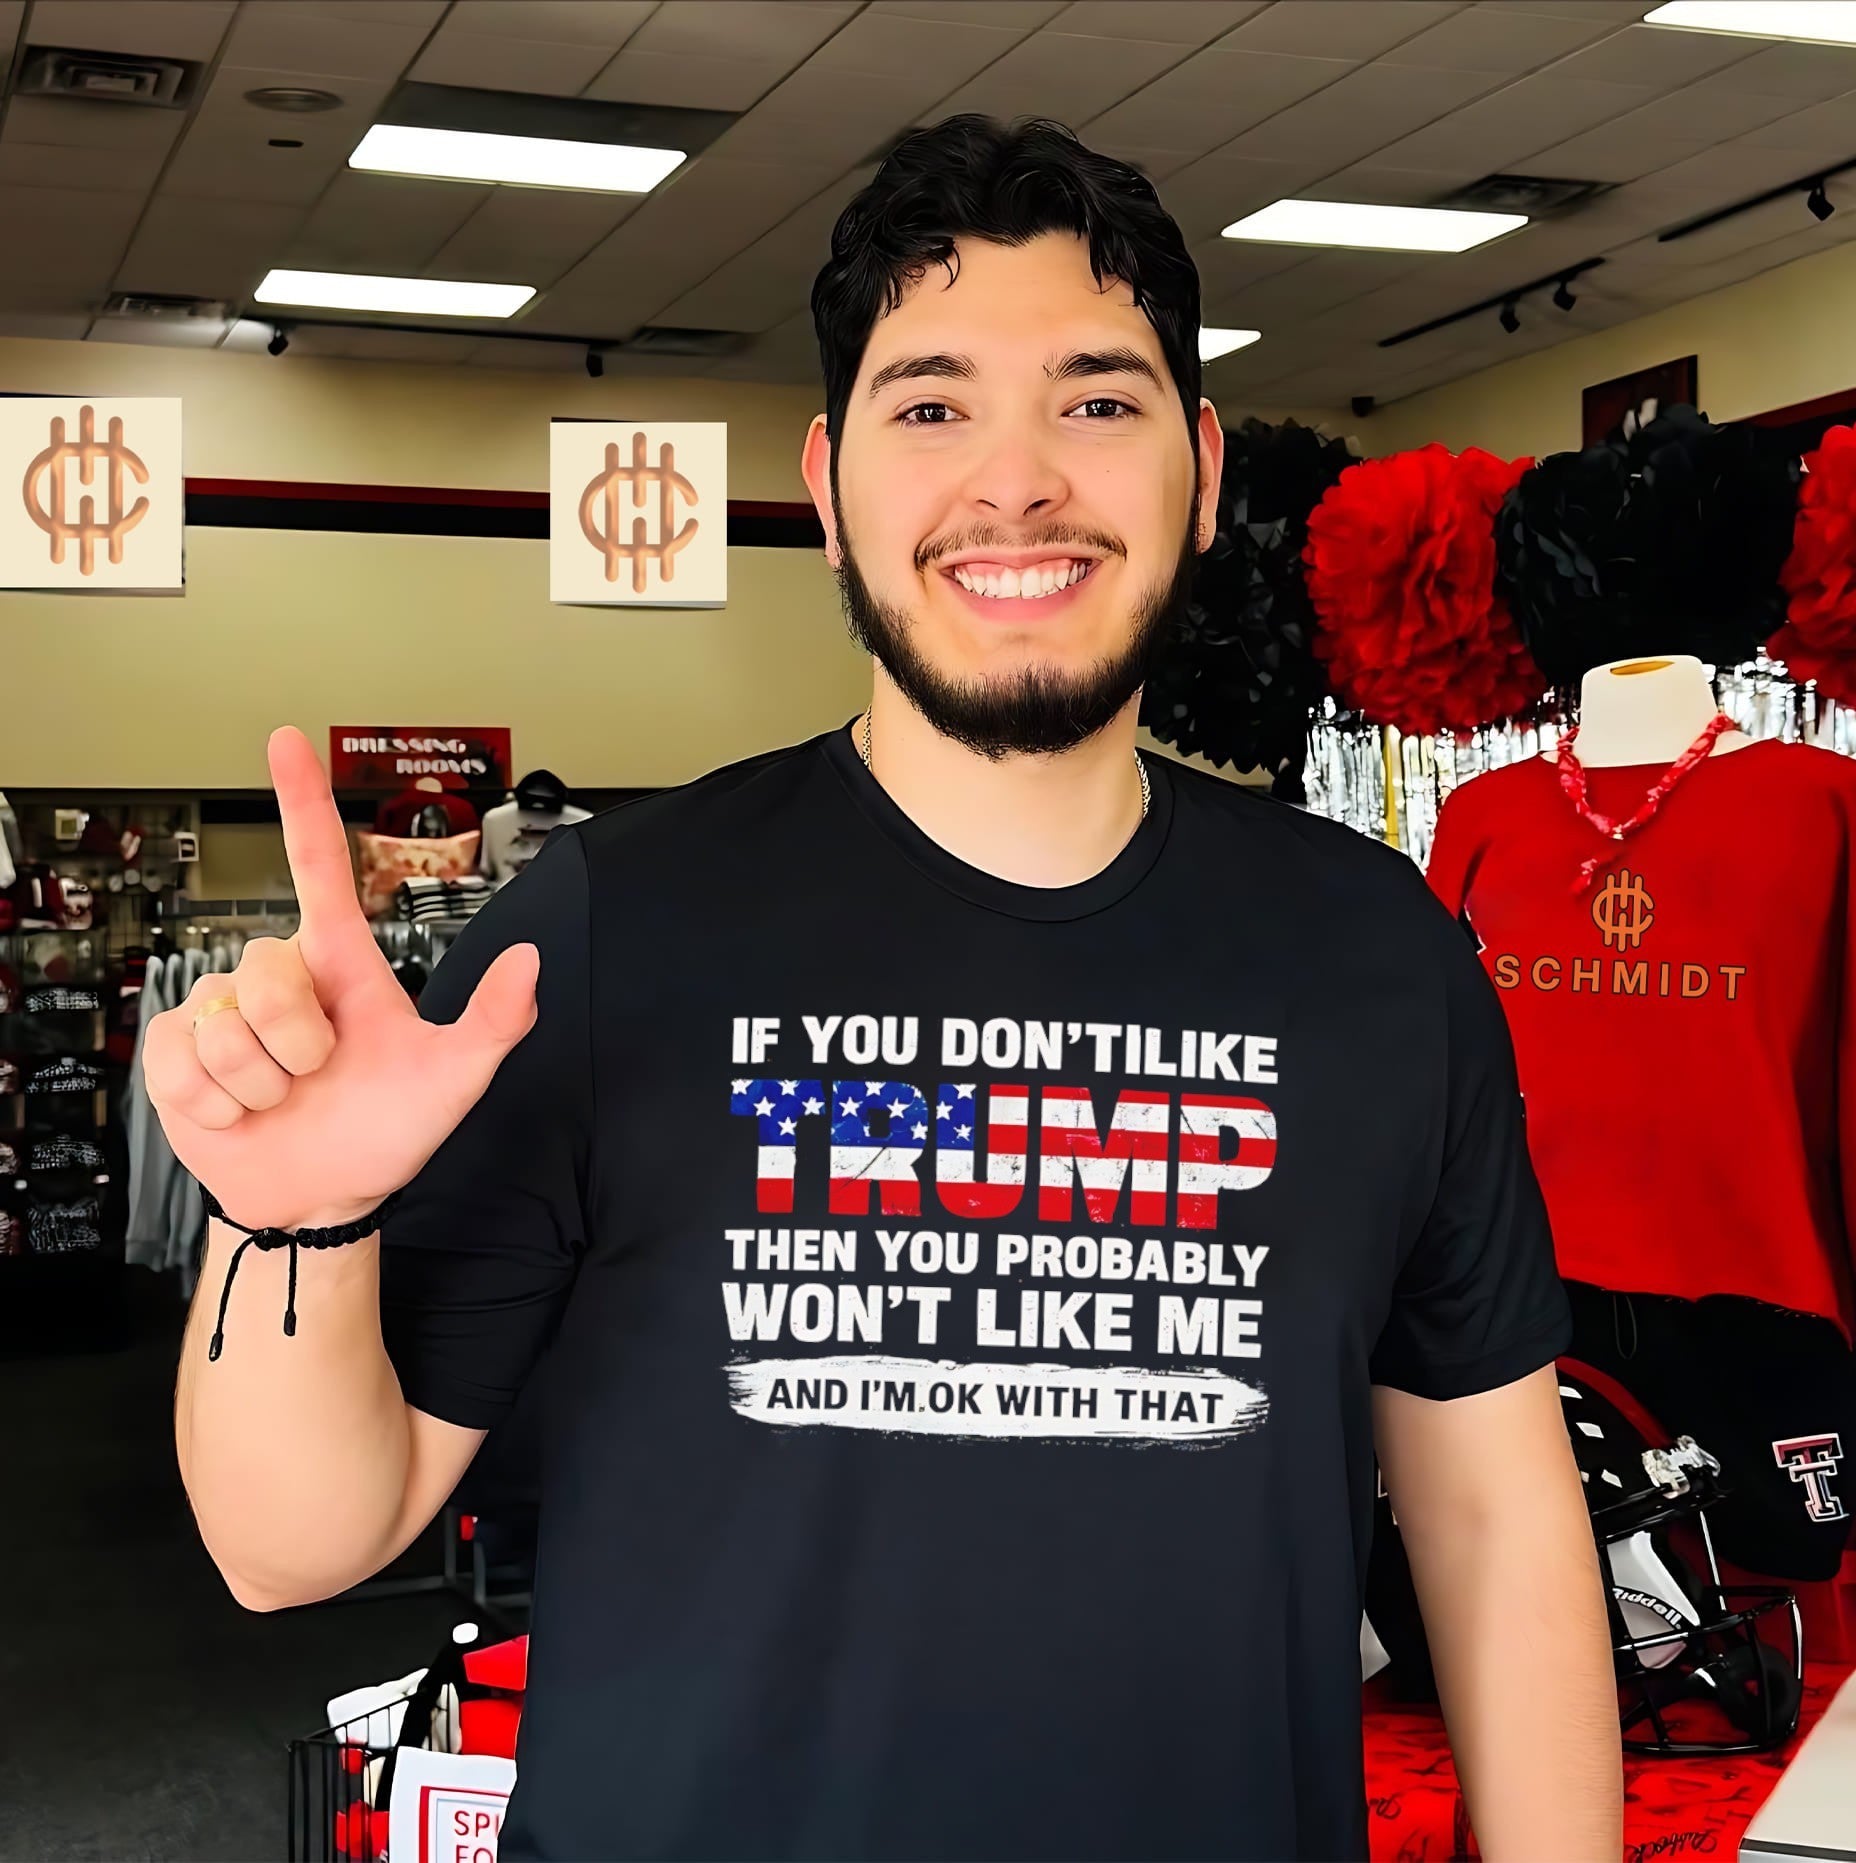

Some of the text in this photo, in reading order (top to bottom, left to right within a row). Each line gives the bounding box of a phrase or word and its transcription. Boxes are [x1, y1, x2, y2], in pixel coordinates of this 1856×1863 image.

[1493, 953, 1747, 1001] SCHMIDT
[731, 1016, 781, 1064] IF
[801, 1014, 919, 1066] YOU
[730, 1078, 1278, 1230] TRUMP
[724, 1229, 1270, 1288] THEN YOU PROBABLY
[721, 1283, 1264, 1359] WON'T LIKE ME
[766, 1378, 849, 1411] AND
[927, 1381, 983, 1415] OK
[995, 1384, 1099, 1420] WITH
[1113, 1388, 1224, 1425] THAT
